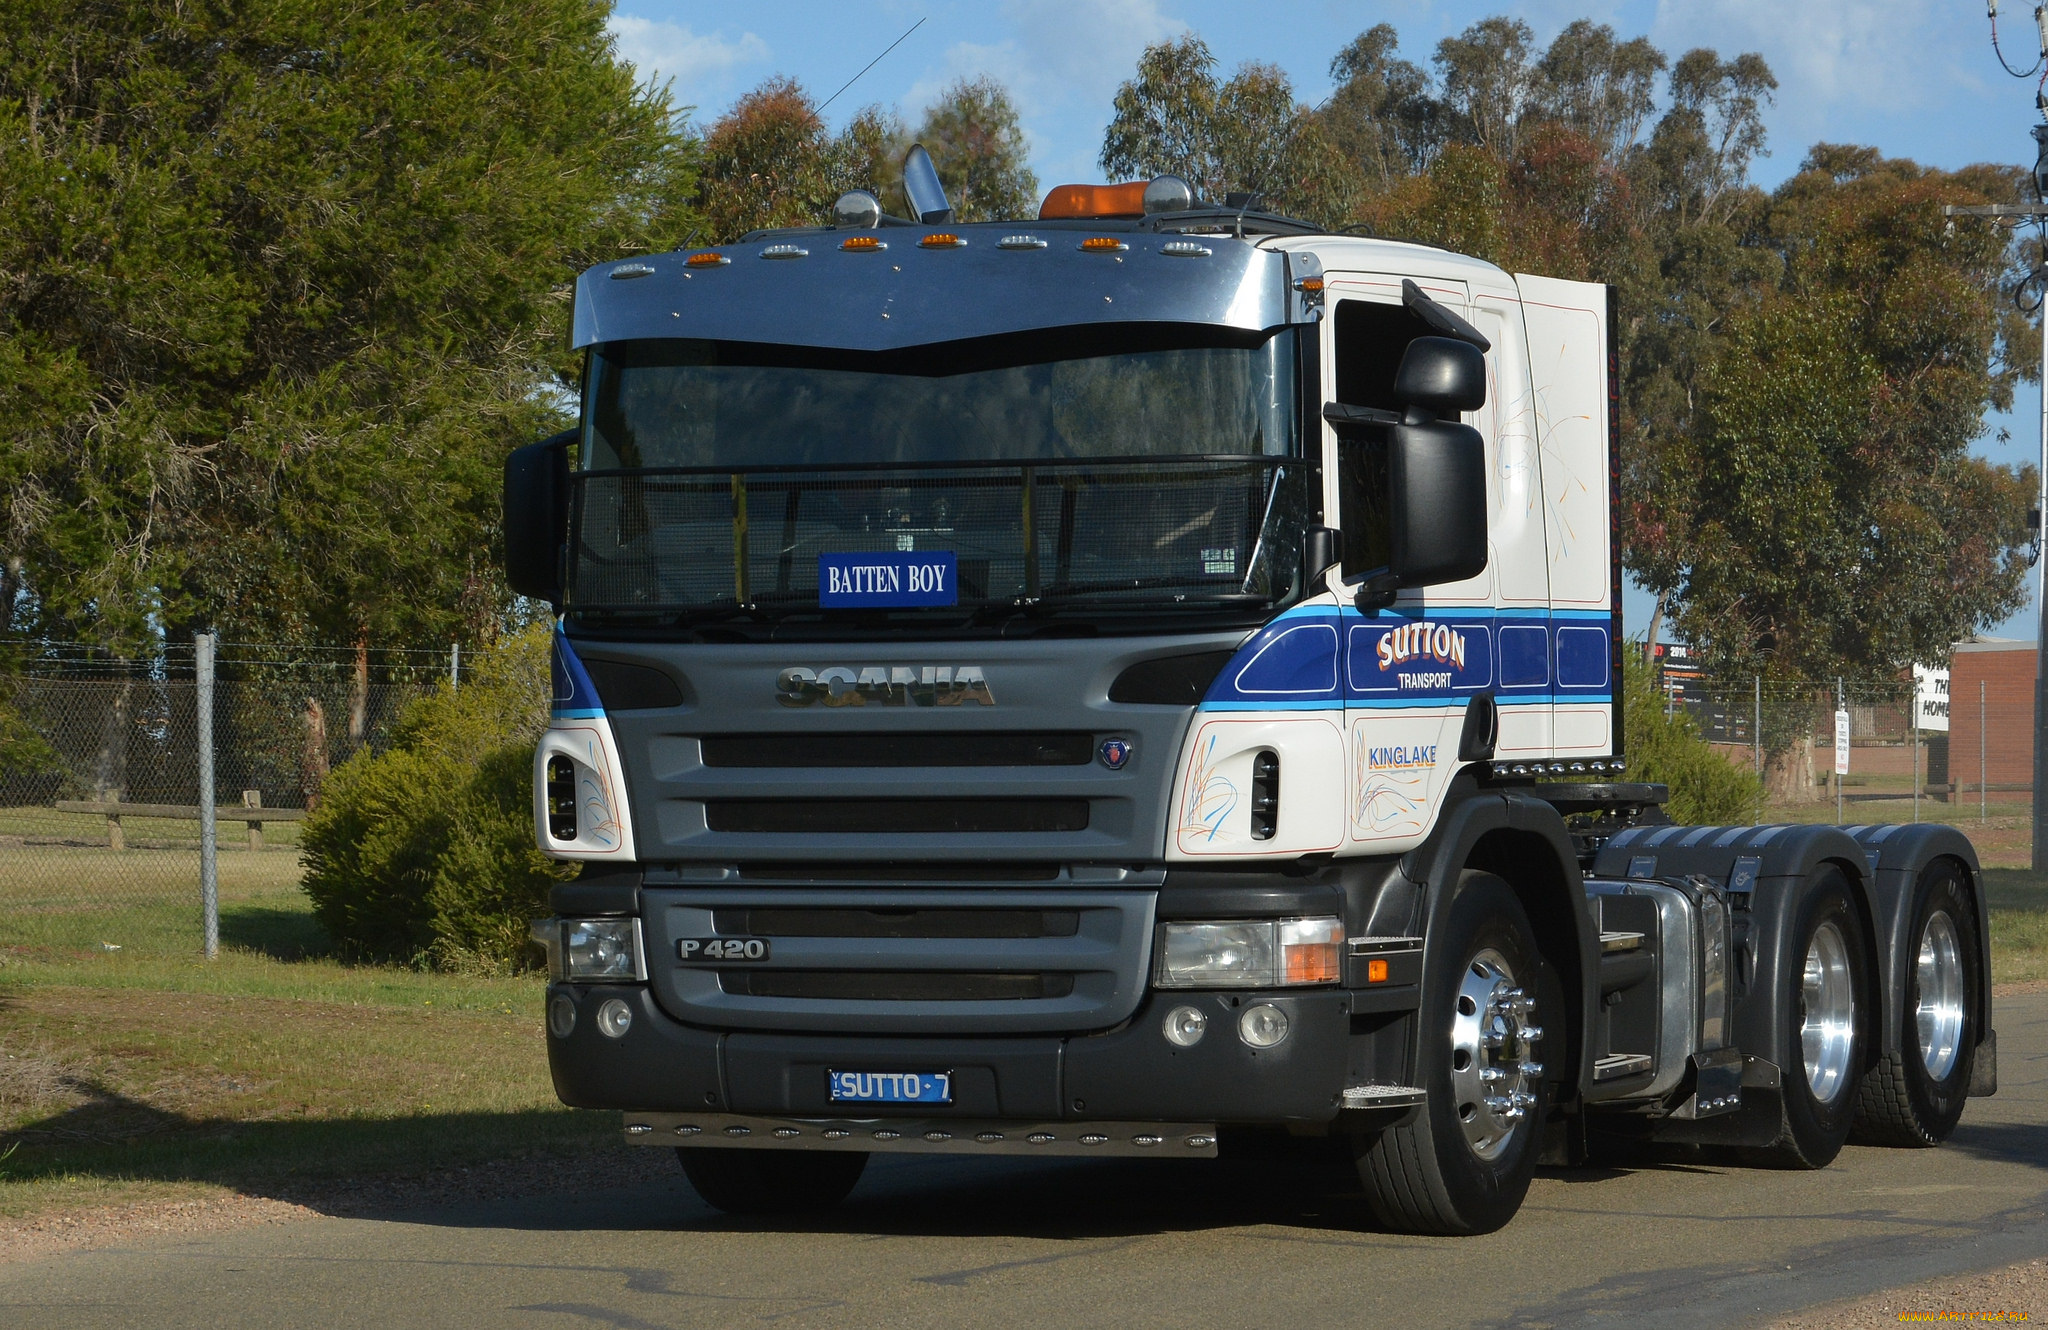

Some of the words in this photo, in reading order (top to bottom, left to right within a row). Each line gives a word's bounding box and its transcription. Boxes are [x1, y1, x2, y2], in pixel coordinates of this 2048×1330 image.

[828, 565, 899, 593] BATTEN
[908, 565, 946, 592] BOY
[1376, 622, 1466, 672] SUTTON
[1670, 646, 1687, 658] 2014
[776, 667, 995, 708] SCANIA
[1398, 672, 1452, 689] TRANSPORT
[1368, 745, 1437, 769] KINGLAKE
[832, 1073, 841, 1097] VIC
